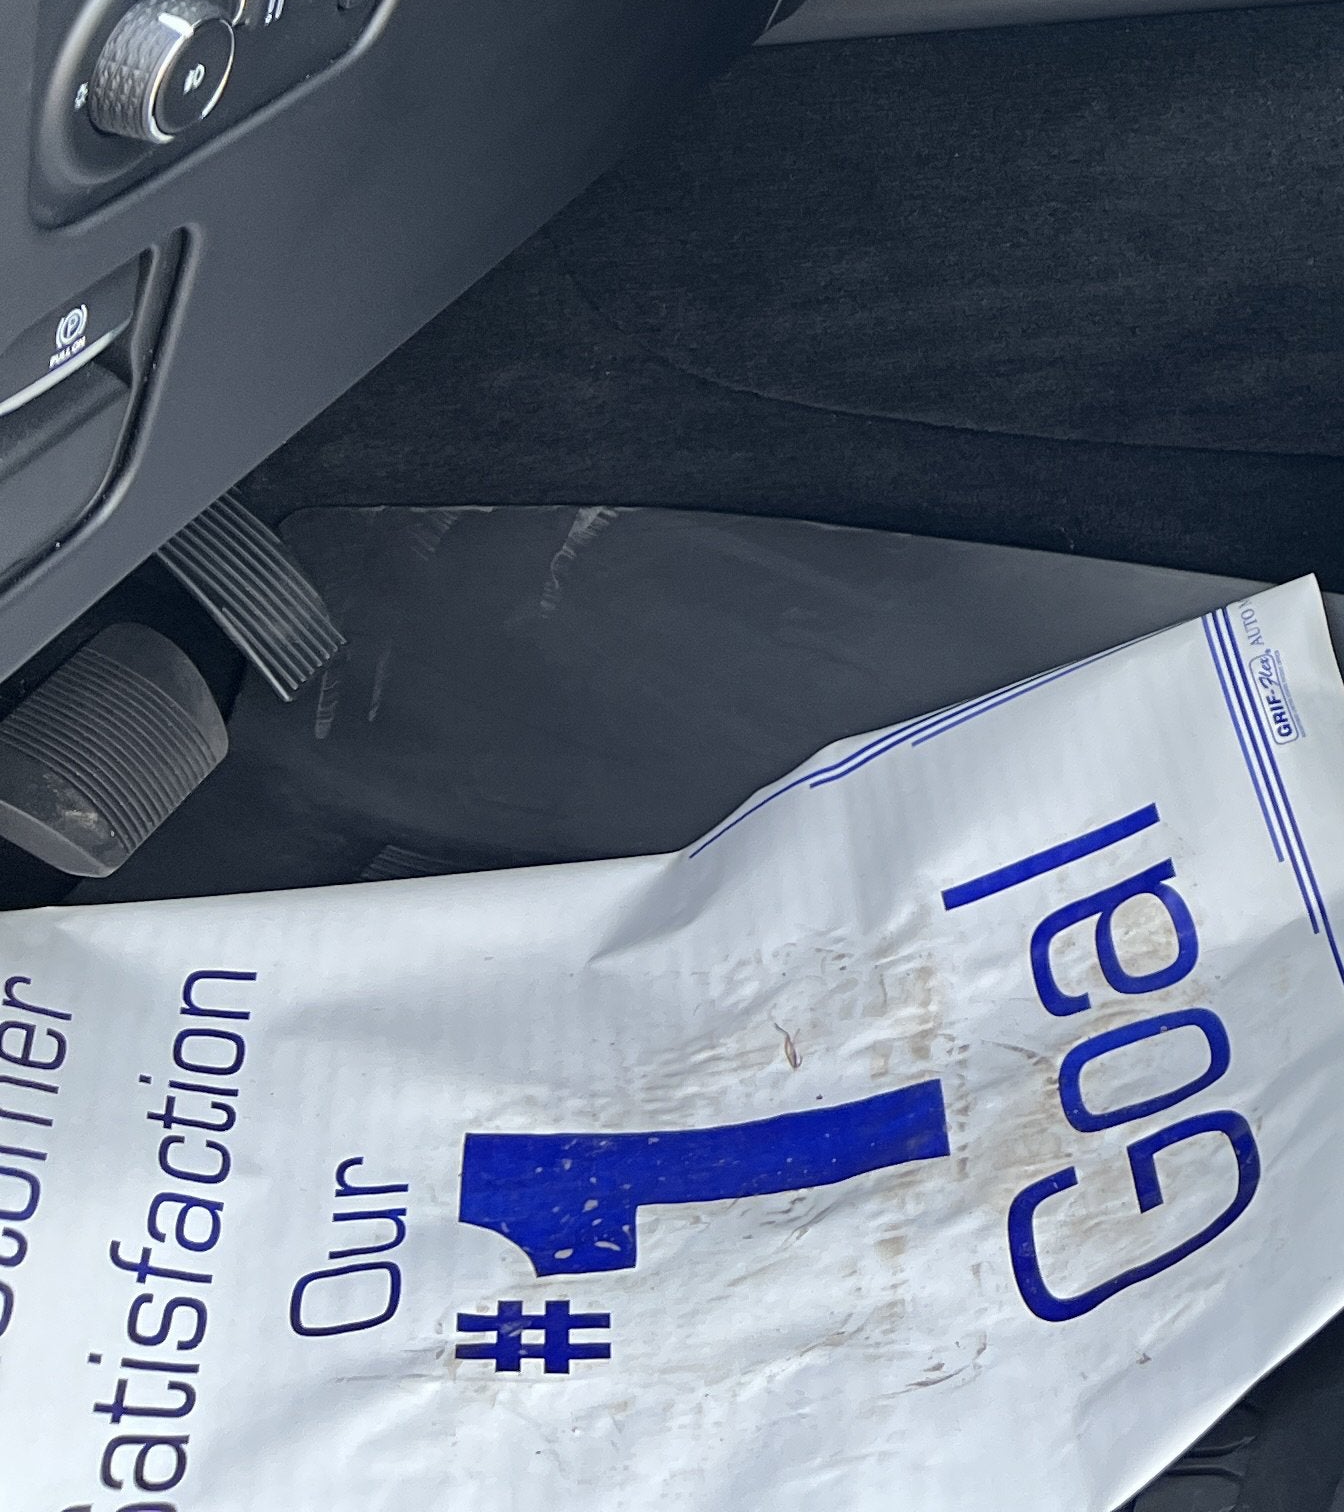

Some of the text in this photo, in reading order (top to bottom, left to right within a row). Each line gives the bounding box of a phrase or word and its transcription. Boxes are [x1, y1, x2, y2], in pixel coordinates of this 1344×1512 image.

[61, 969, 258, 1512] atisfaction
[289, 1156, 409, 1337] Our
[455, 1078, 950, 1375] #1
[941, 801, 1261, 1323] Goal
